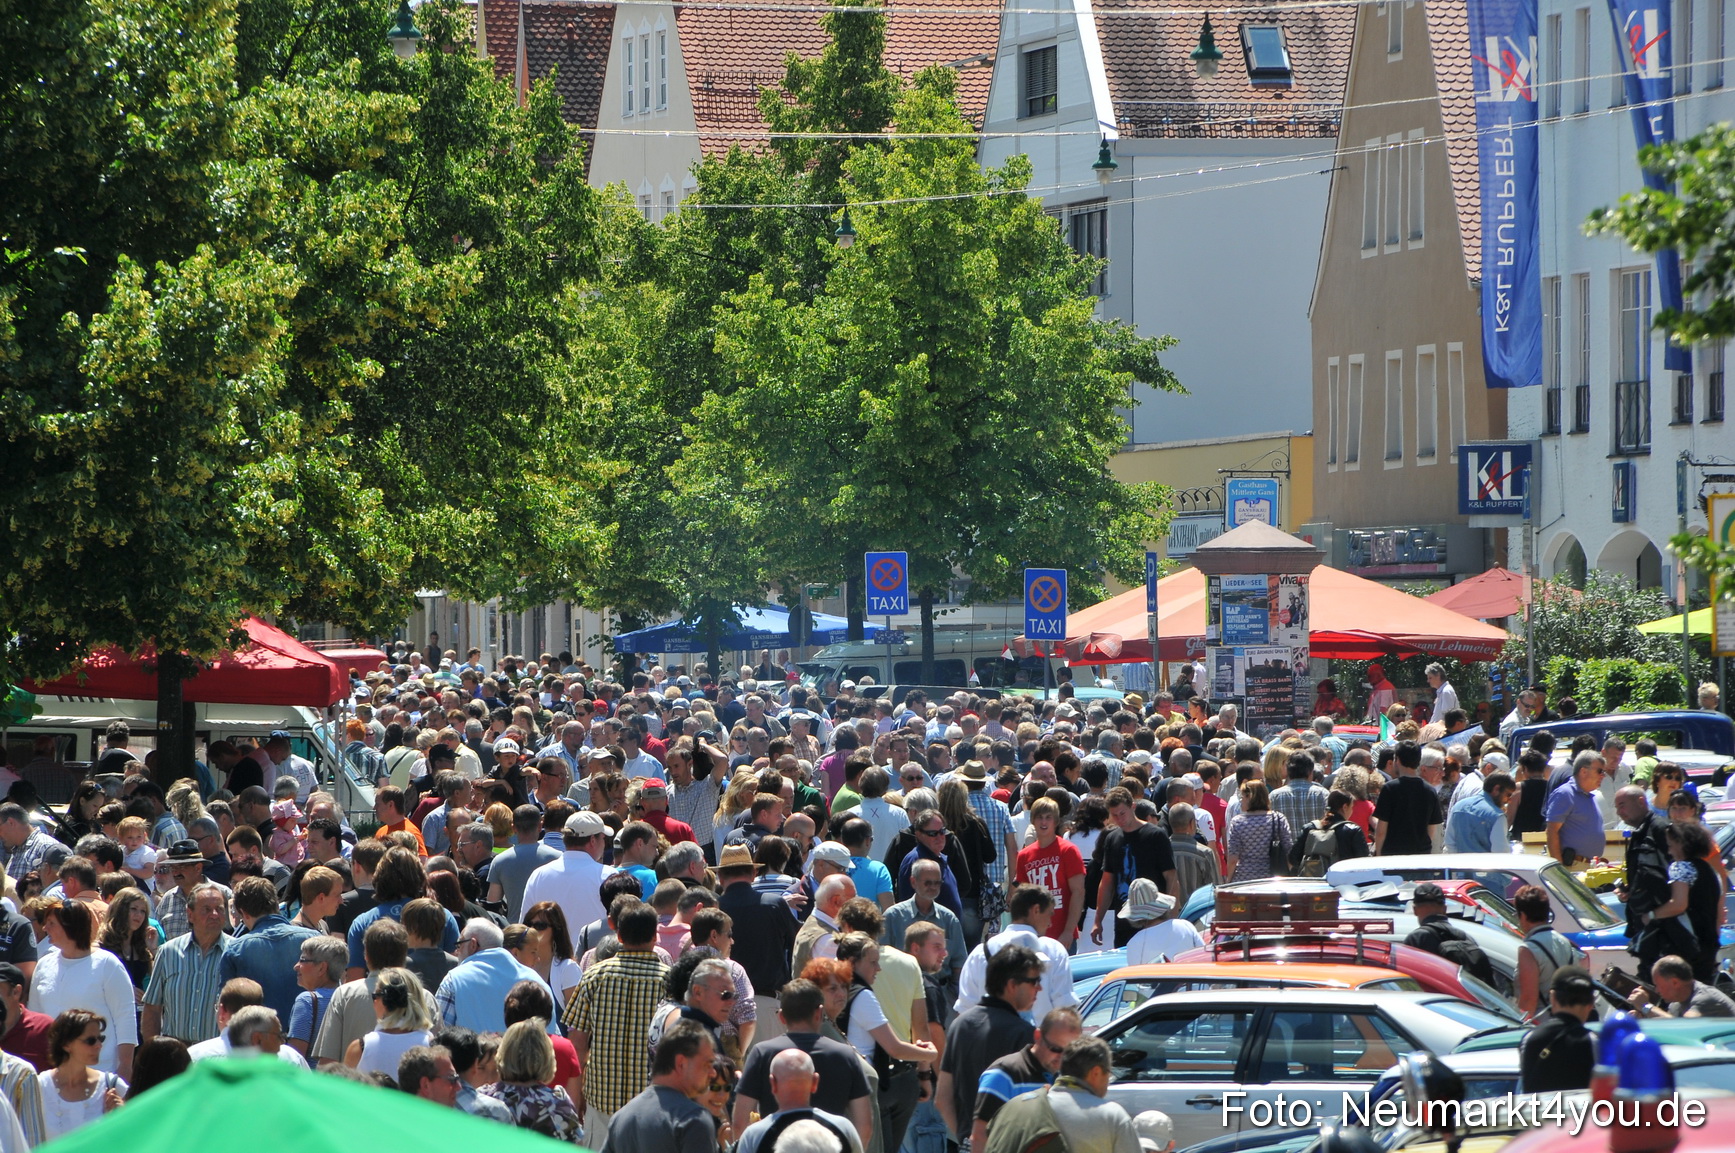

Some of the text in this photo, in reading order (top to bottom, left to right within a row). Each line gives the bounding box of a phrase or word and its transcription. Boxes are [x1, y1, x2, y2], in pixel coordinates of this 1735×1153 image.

[1467, 451, 1524, 501] K&L
[1238, 481, 1268, 489] Gasthaus
[1468, 501, 1484, 509] K&L
[870, 596, 905, 610] TAXI
[1028, 618, 1062, 634] TAXI
[1185, 636, 1206, 656] Glo
[1439, 640, 1497, 655] Lehmeier
[1024, 855, 1060, 871] TOPDOLLAR
[1026, 864, 1060, 890] THEY
